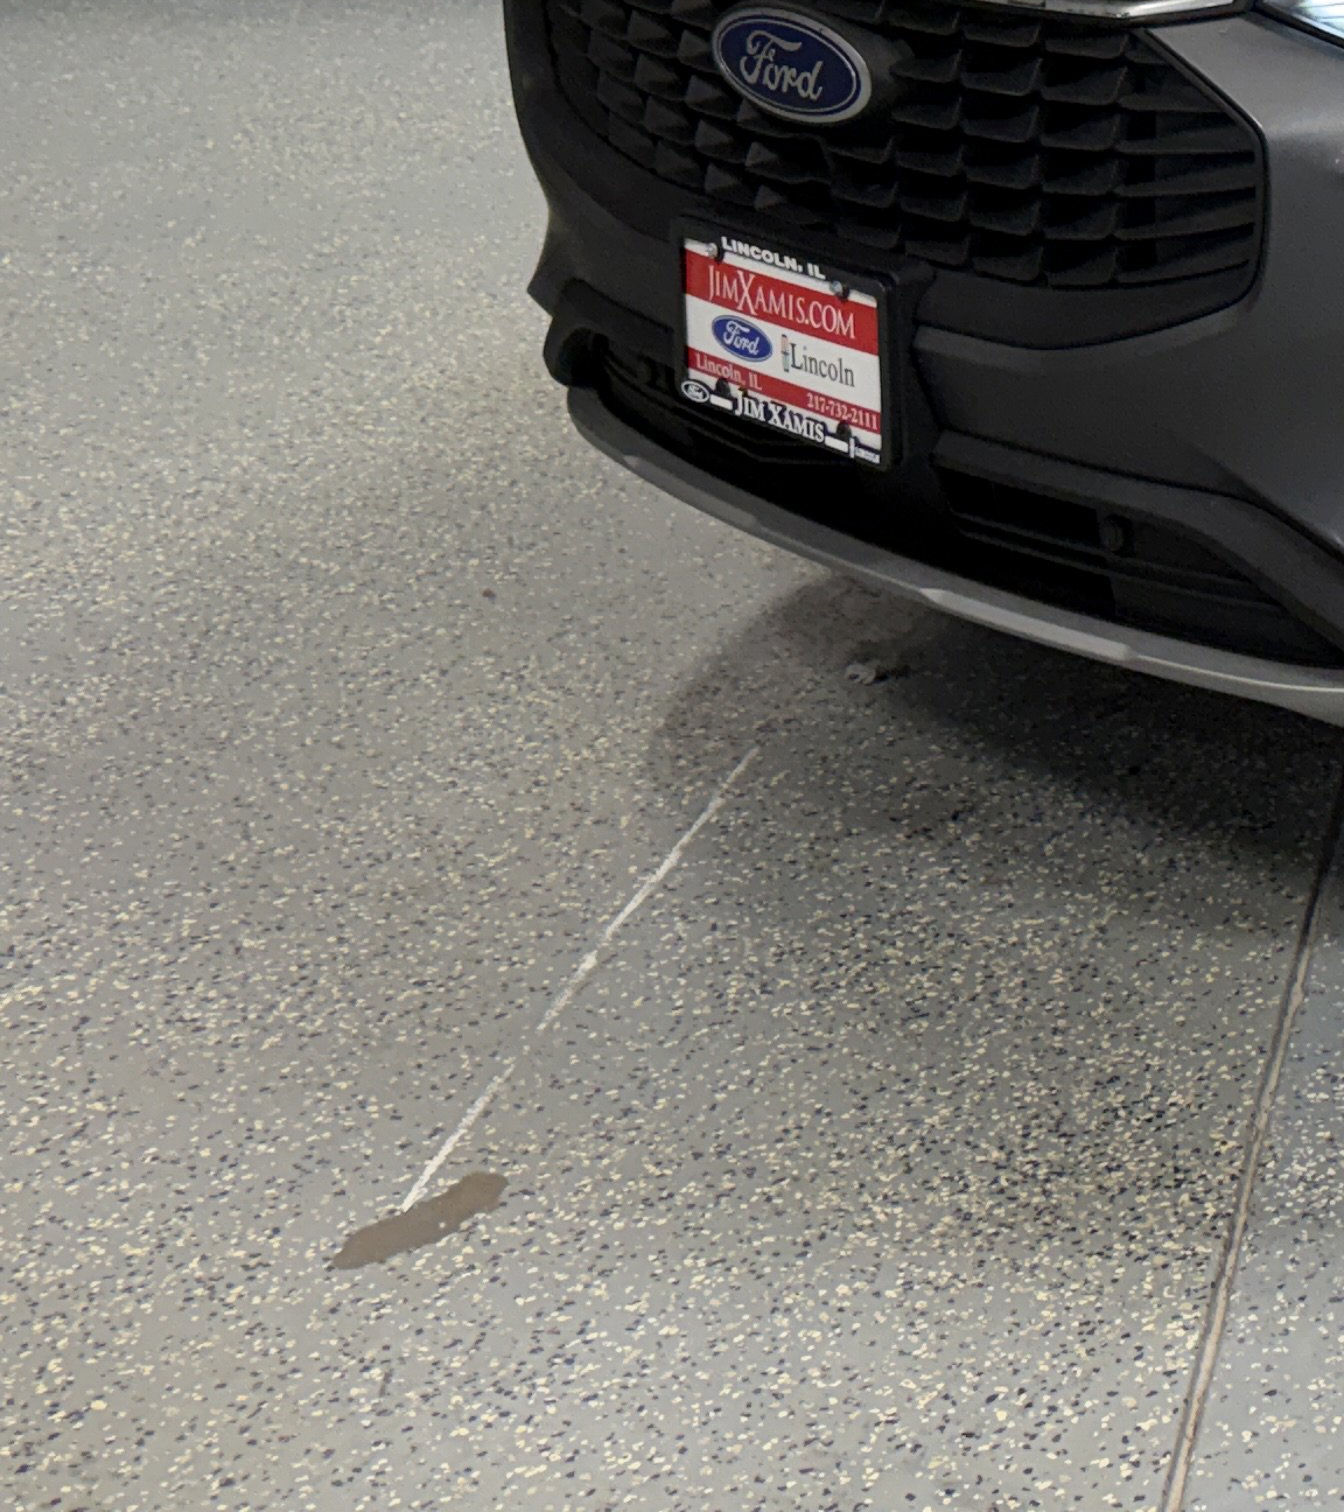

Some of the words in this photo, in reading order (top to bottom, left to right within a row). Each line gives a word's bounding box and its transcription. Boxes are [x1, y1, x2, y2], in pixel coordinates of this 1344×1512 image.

[739, 29, 824, 101] Ford
[806, 262, 827, 281] IL
[707, 264, 857, 340] JIMXAMIS.COM
[723, 320, 760, 357] Ford
[789, 343, 856, 388] Lincoln
[734, 392, 766, 423] JIM
[768, 401, 826, 444] XAMIS
